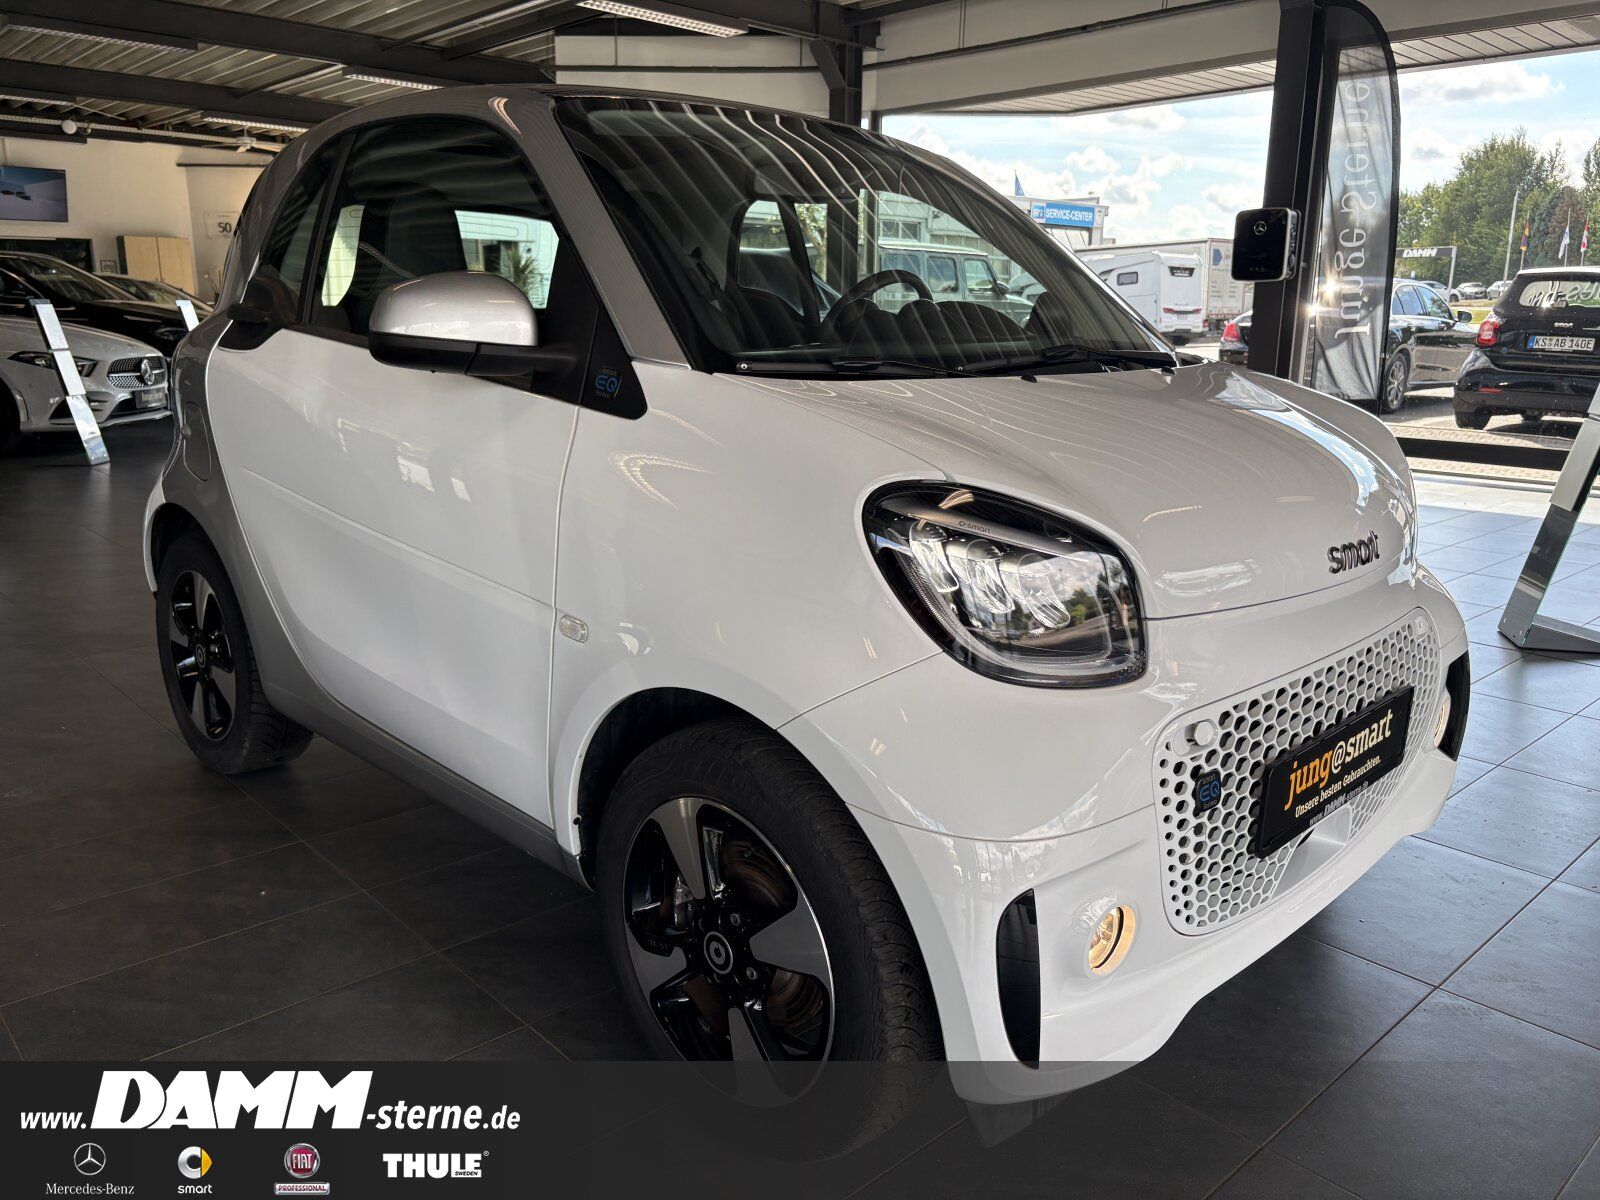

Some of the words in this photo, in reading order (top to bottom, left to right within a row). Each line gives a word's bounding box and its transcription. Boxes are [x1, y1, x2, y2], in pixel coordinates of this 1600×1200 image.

[1045, 208, 1093, 222] SERVICE-CENTER
[218, 222, 232, 233] 50
[1402, 248, 1438, 258] DAMM
[1535, 338, 1548, 347] KS
[1553, 338, 1566, 348] AB
[1568, 339, 1593, 350] 140E
[595, 374, 619, 393] EQ
[967, 522, 992, 534] smart
[1327, 530, 1380, 574] smart
[1284, 709, 1393, 811] jung@smart
[1200, 780, 1220, 801] EQ
[1295, 796, 1319, 818] Unsere
[1320, 780, 1342, 802] besten
